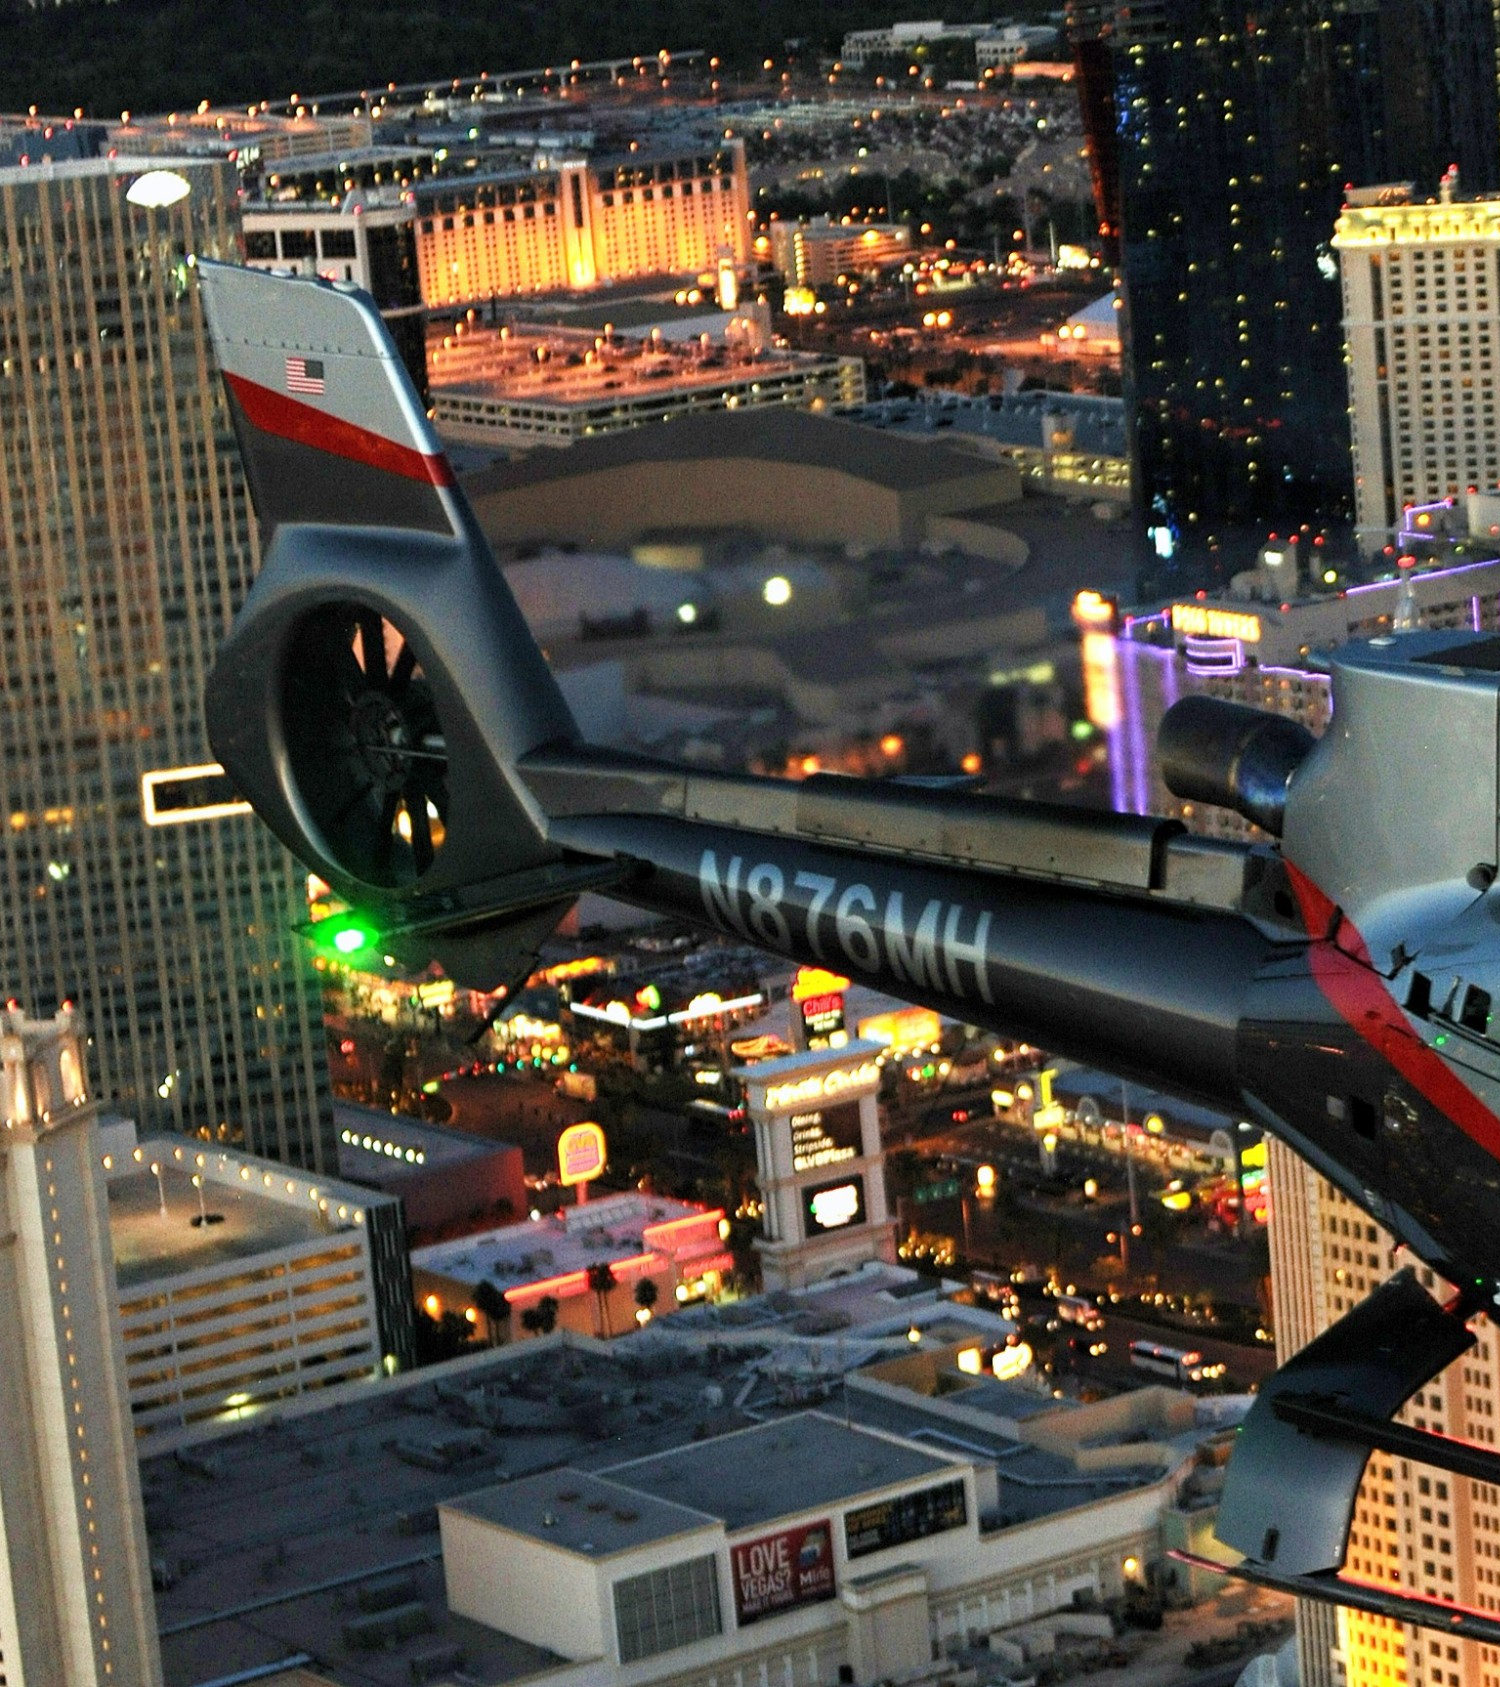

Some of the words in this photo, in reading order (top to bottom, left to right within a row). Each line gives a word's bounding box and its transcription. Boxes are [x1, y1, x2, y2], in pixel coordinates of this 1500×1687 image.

[700, 850, 995, 1005] N876MH
[738, 1537, 790, 1580] LOVE
[741, 1568, 792, 1600] VEGAS?
